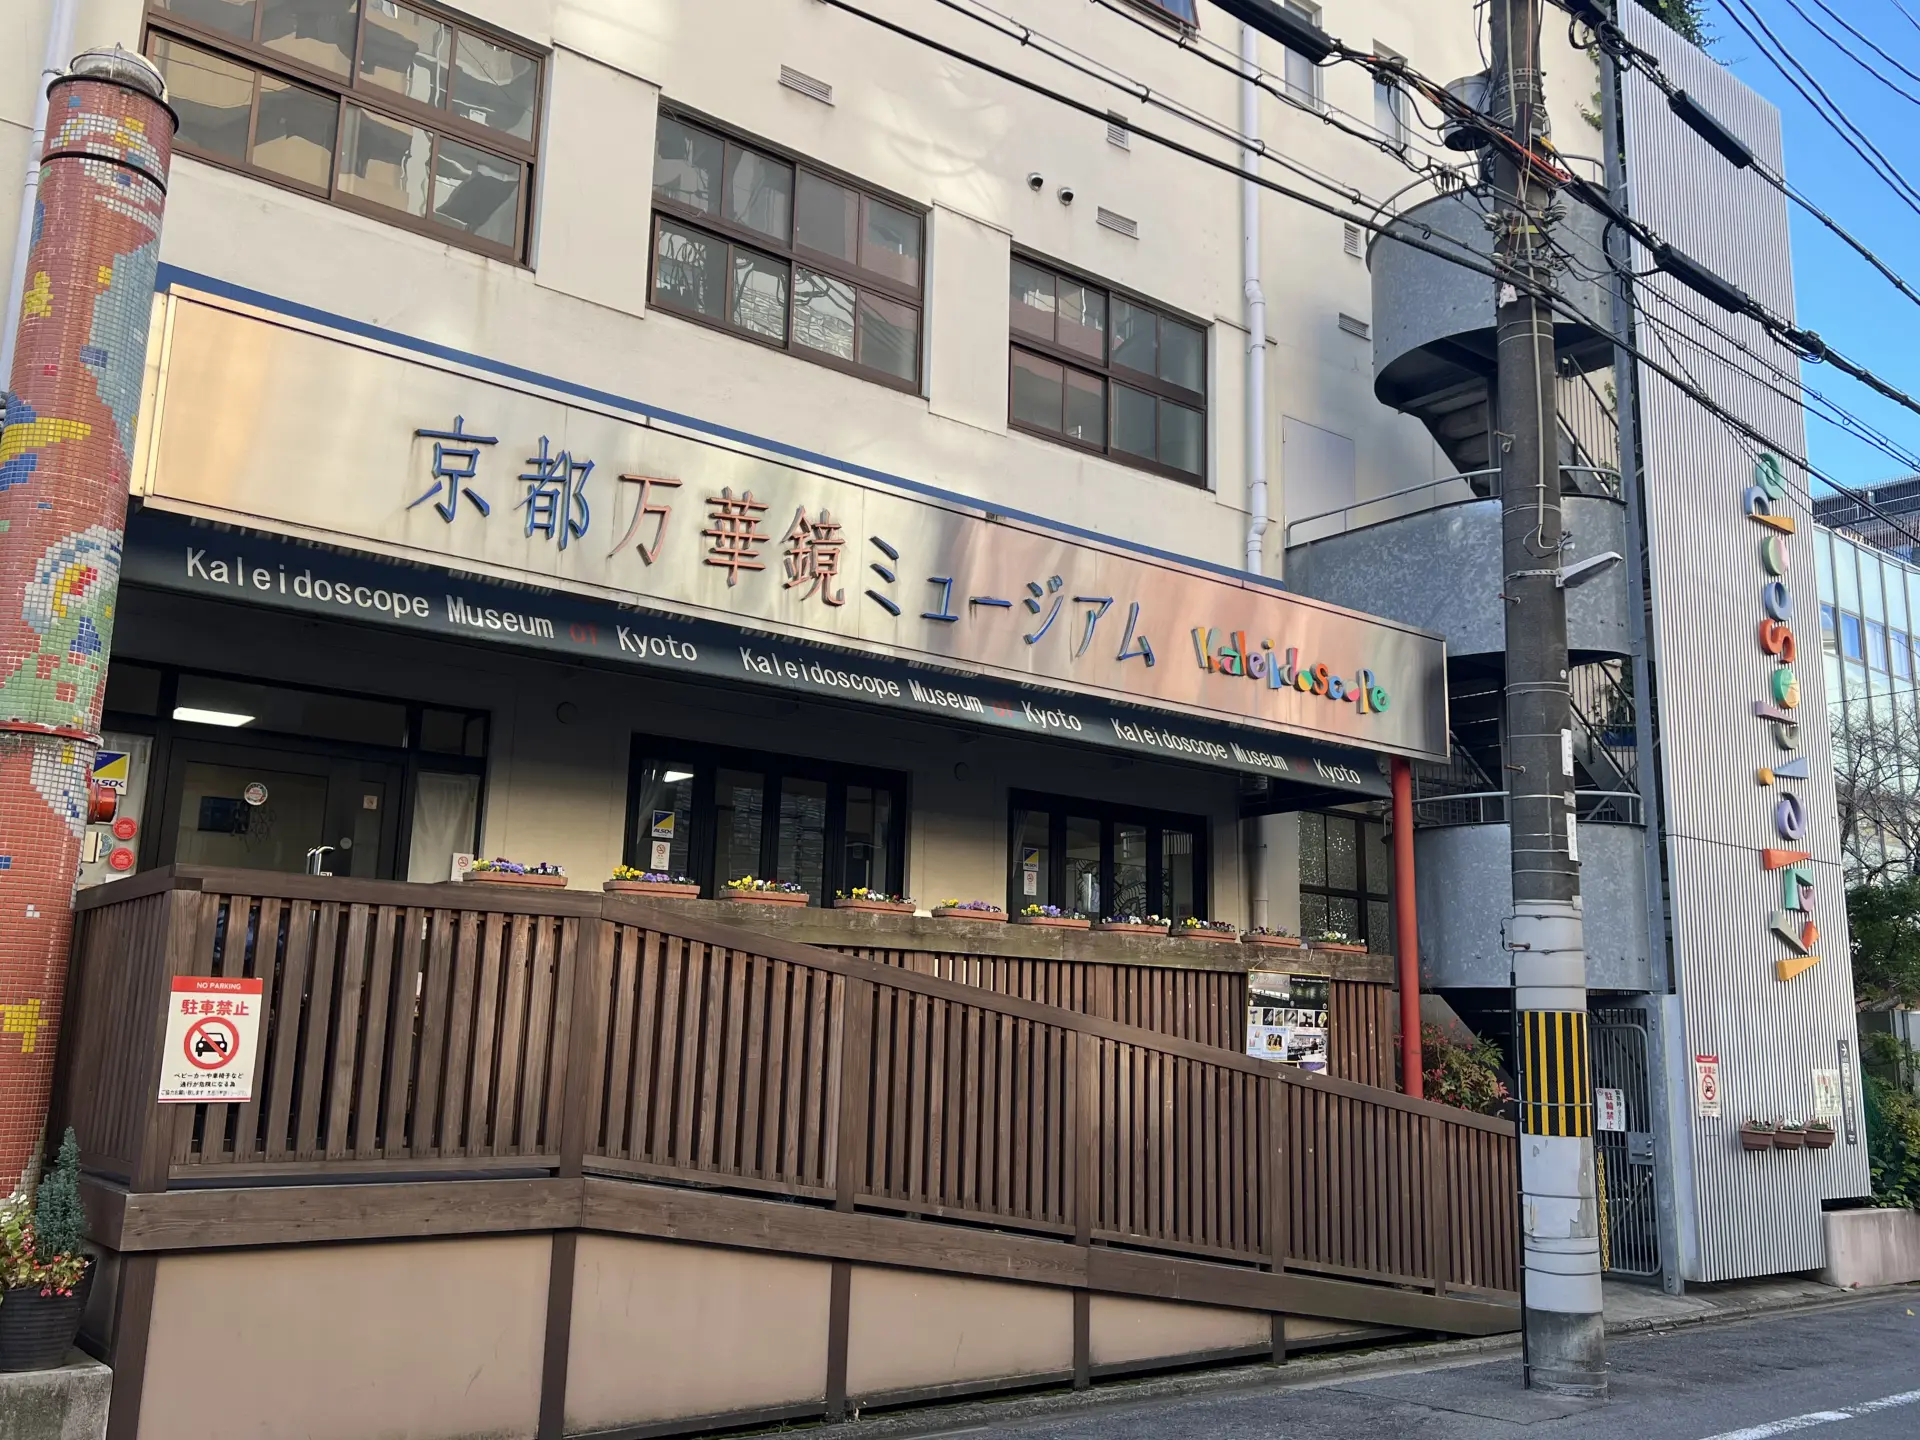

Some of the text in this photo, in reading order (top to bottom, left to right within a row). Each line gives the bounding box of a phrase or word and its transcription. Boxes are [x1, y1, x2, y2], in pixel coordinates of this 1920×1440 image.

[406, 414, 1155, 668] 京都万華鏡ミュージアム
[185, 546, 430, 619] Kaleidoscope
[446, 594, 555, 640] Museum
[615, 624, 698, 662] Kyoto
[739, 646, 901, 699] Kaleidoscope
[907, 678, 985, 714] Museum
[1020, 700, 1083, 733] Kyoto
[1191, 625, 1391, 715] Kaleidoscope
[1109, 717, 1228, 761] Kaleidoscope
[1228, 741, 1289, 772] Museum
[1312, 757, 1361, 785] Kyoto
[181, 999, 249, 1015] 駐車禁止
[209, 982, 242, 990] PARKING
